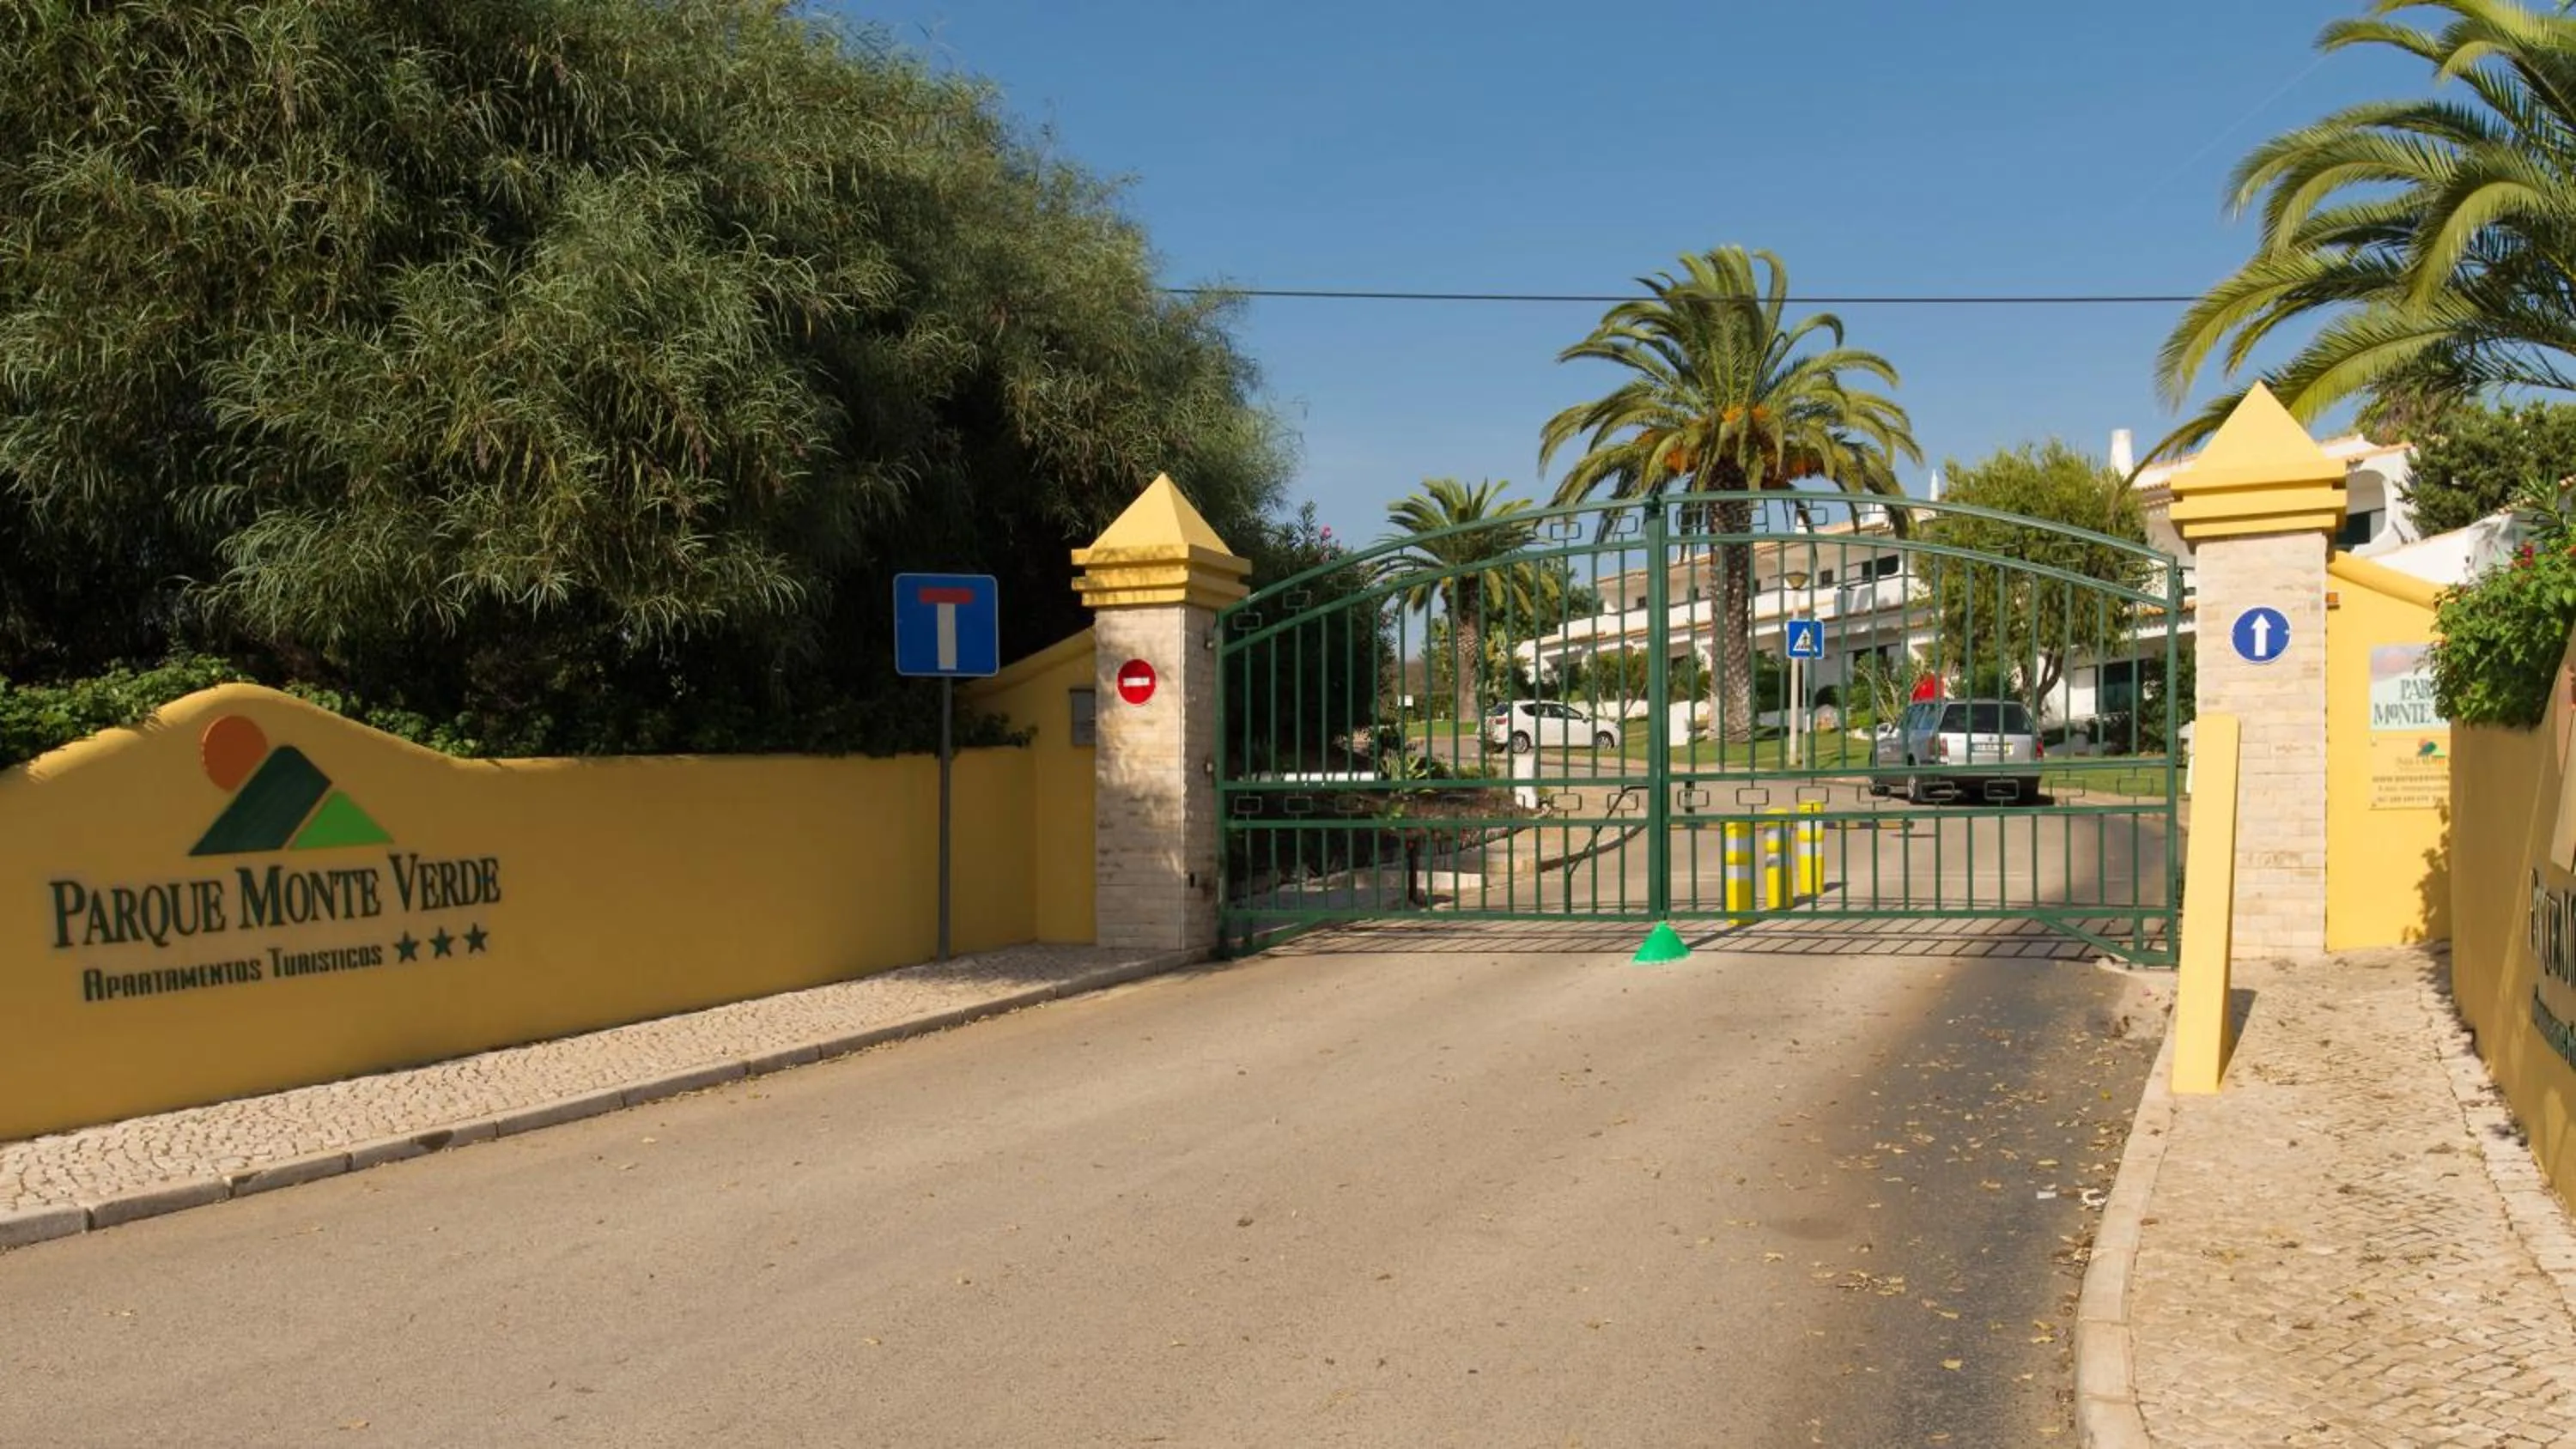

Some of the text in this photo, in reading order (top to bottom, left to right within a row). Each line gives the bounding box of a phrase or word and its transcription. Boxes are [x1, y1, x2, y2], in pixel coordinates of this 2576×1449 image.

[2400, 678, 2433, 700] PAR
[2373, 702, 2431, 725] MONTE
[49, 853, 501, 949] PARQUE MONTE VERDE
[82, 946, 382, 1002] APARTAMENTOS TURISTICOS
